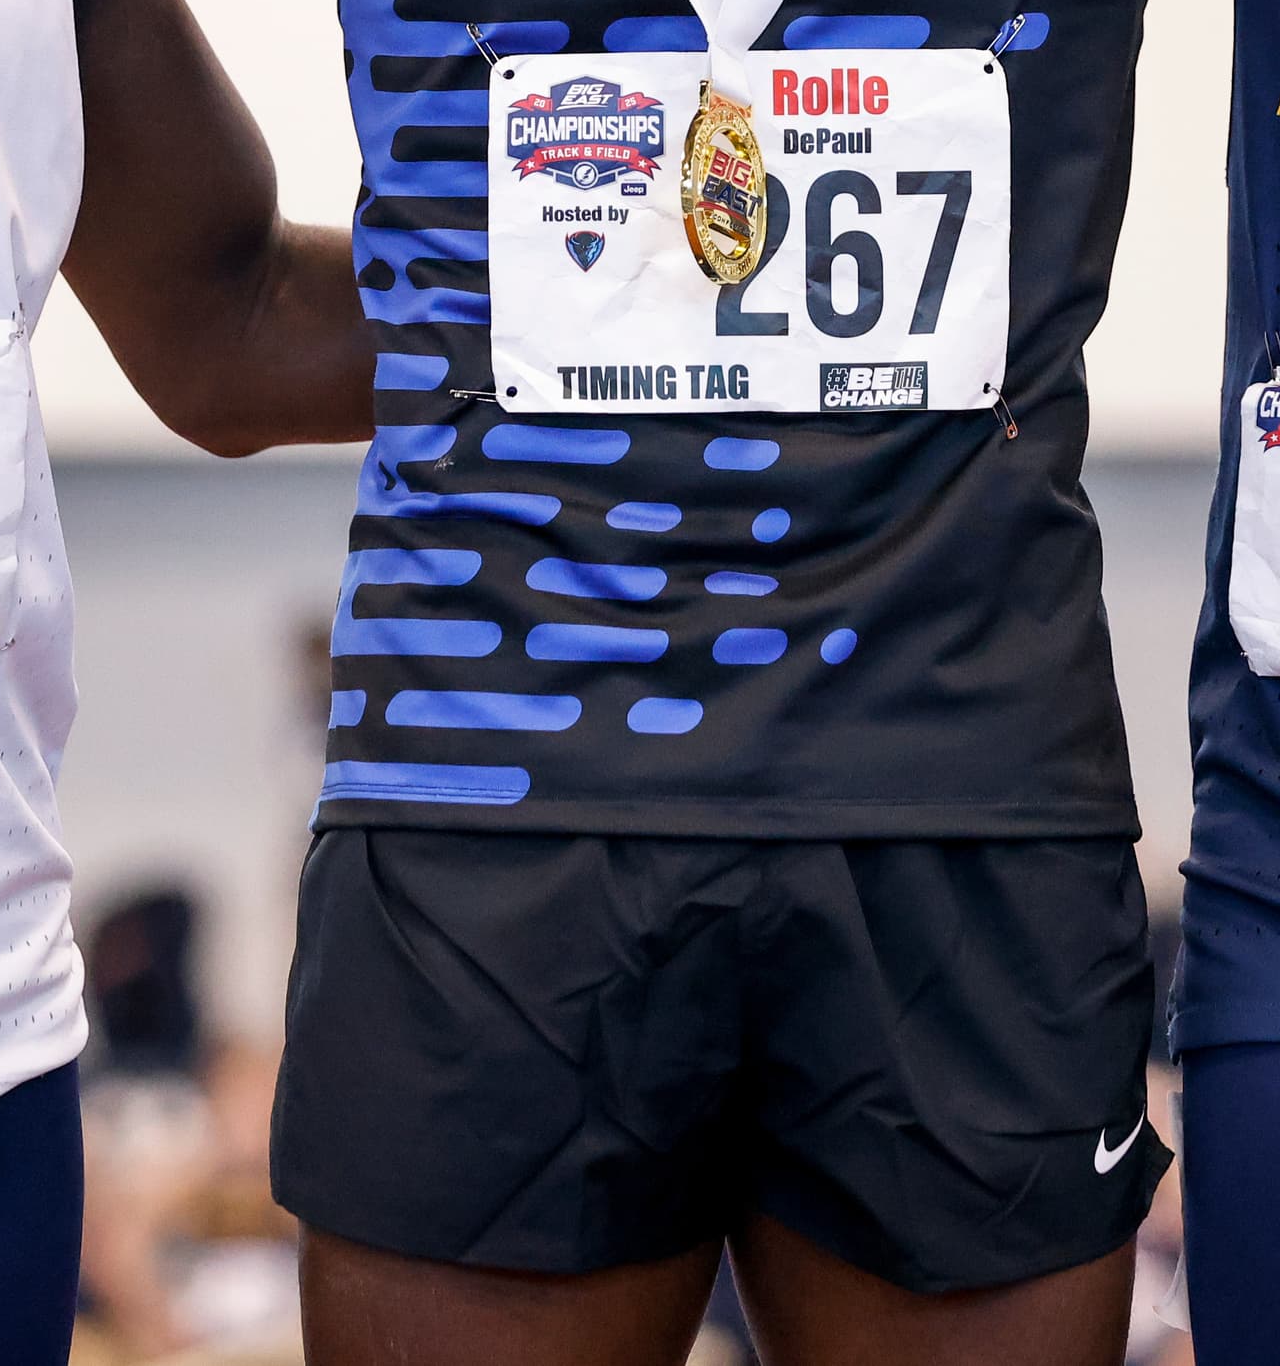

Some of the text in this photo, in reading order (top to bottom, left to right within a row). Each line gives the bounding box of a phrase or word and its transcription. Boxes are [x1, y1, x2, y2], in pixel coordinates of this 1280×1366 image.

[561, 94, 613, 105] EAST
[567, 84, 604, 95] BIG
[773, 68, 889, 116] Rolle
[534, 98, 637, 107] 20 25
[511, 116, 660, 146] CHAMPIONSHIPS
[783, 128, 871, 154] DePaul
[541, 147, 630, 160] TRACK & FIELD
[709, 149, 752, 189] BIG
[623, 185, 644, 194] Jeep
[703, 175, 762, 218] EAST
[542, 205, 629, 225] Hosted by
[715, 170, 972, 338] 267
[557, 365, 749, 401] TIMING TAG
[824, 389, 924, 407] CHANGE
